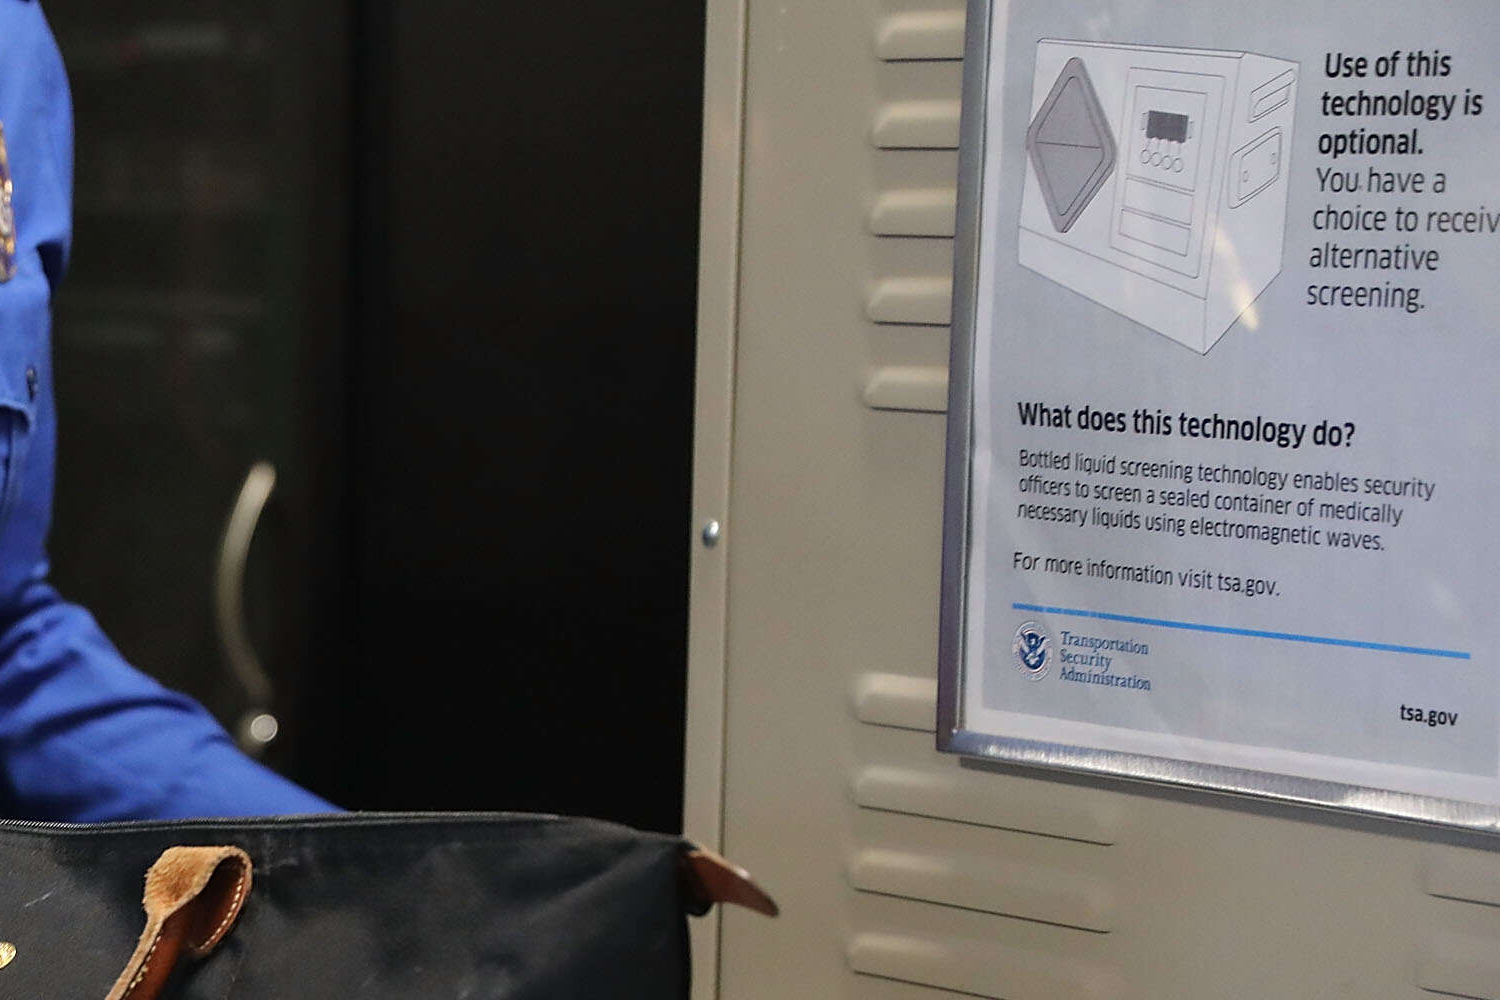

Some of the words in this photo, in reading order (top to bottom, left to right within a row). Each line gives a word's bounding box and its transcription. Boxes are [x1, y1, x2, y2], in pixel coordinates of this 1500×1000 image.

[1325, 52, 1368, 78] Use
[1375, 50, 1401, 78] of
[1406, 50, 1452, 78] this
[1321, 89, 1457, 121] technology
[1463, 88, 1484, 116] is
[1318, 128, 1424, 159] optional.
[1316, 166, 1360, 193] You
[1367, 166, 1425, 194] have
[1432, 172, 1446, 194] a
[1312, 204, 1387, 232] choice
[1395, 206, 1419, 232] to
[1426, 205, 1500, 233] receiv
[1309, 241, 1440, 271] alternative
[1307, 280, 1426, 314] screening.
[1017, 402, 1073, 429] What
[1077, 405, 1127, 432] does
[1132, 409, 1173, 436] this
[1179, 412, 1307, 449] technology
[1313, 420, 1356, 447] do?
[1019, 449, 1071, 471] Bottled
[1074, 451, 1117, 476] liquid
[1120, 460, 1193, 484] screening
[1197, 463, 1289, 491] technology
[1293, 471, 1359, 493] enables
[1364, 476, 1436, 501] security
[1019, 474, 1071, 497] officers
[1074, 480, 1090, 499] to
[1093, 484, 1142, 503] screen
[1146, 490, 1156, 504] a
[1159, 488, 1210, 509] sealed
[1214, 494, 1292, 516] container
[1297, 498, 1315, 517] of
[1319, 502, 1404, 528] medically
[1017, 502, 1088, 528] necessary
[1092, 506, 1141, 530] liquids
[1145, 513, 1186, 538] using
[1189, 517, 1321, 546] electromagnetic
[1326, 528, 1386, 551] waves.
[1012, 551, 1041, 571] For
[1044, 556, 1083, 576] more
[1086, 558, 1174, 587] information
[1178, 568, 1213, 590] visit
[1217, 573, 1281, 598] tsa.gov.
[1060, 631, 1149, 655] Transportation
[1060, 649, 1112, 673] Security
[1059, 667, 1151, 691] Administration
[1400, 704, 1459, 727] tsa.gov
